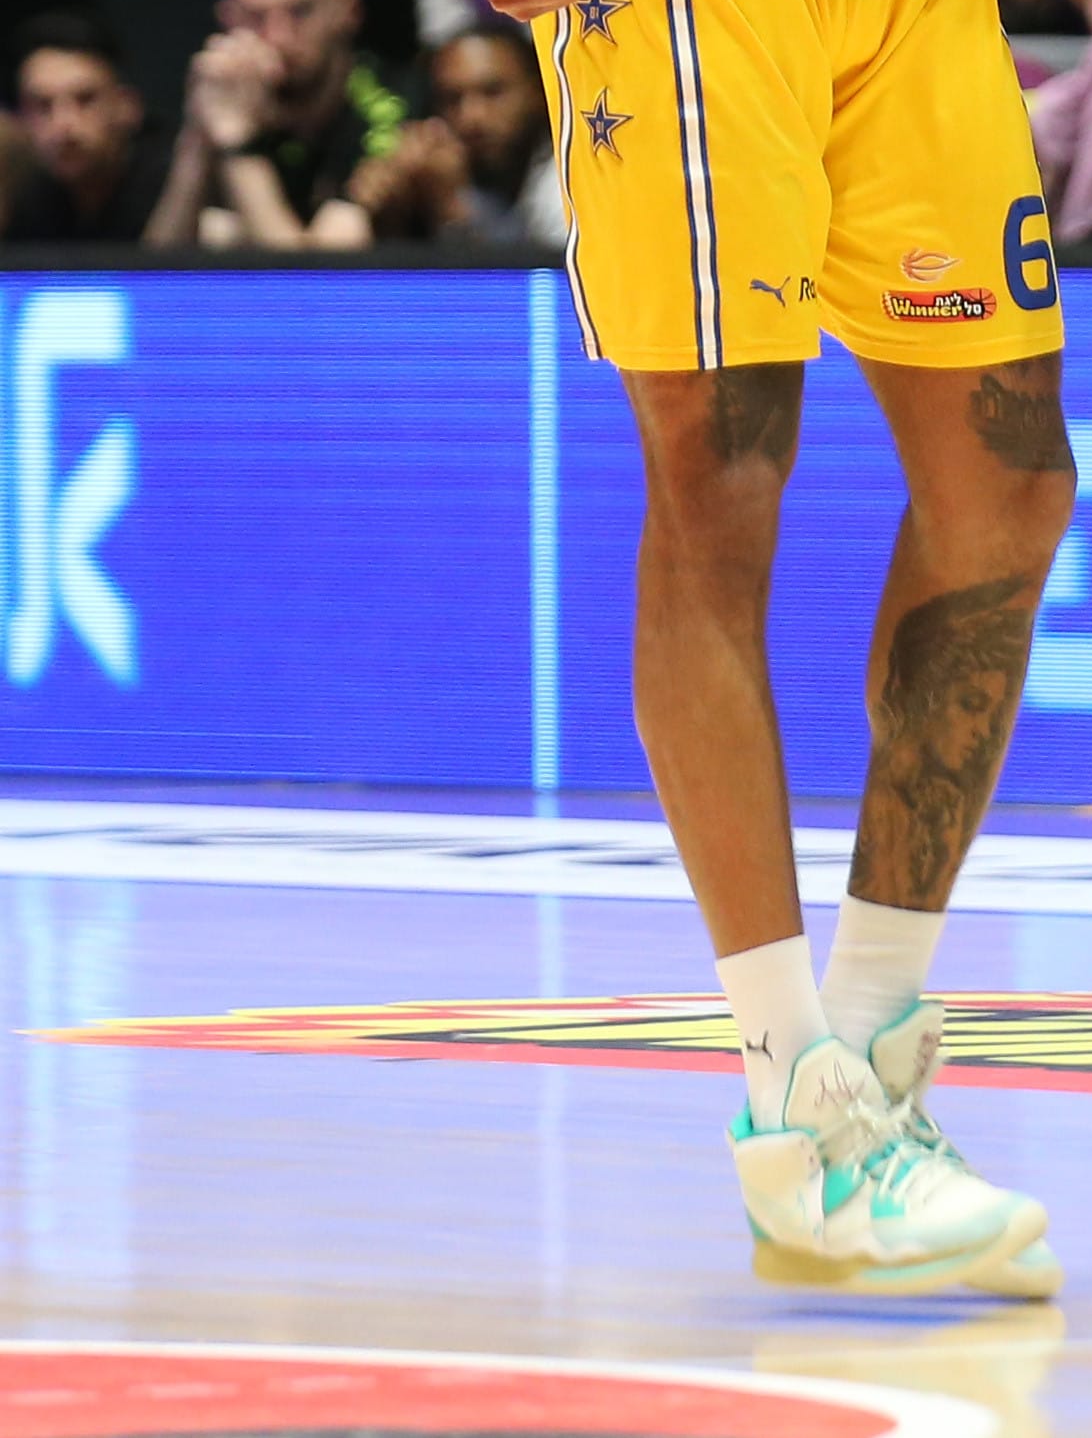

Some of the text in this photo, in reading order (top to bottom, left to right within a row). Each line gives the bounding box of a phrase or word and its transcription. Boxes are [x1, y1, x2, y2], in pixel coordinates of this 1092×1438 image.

[1003, 195, 1058, 310] 6
[892, 297, 983, 317] Winner סל
